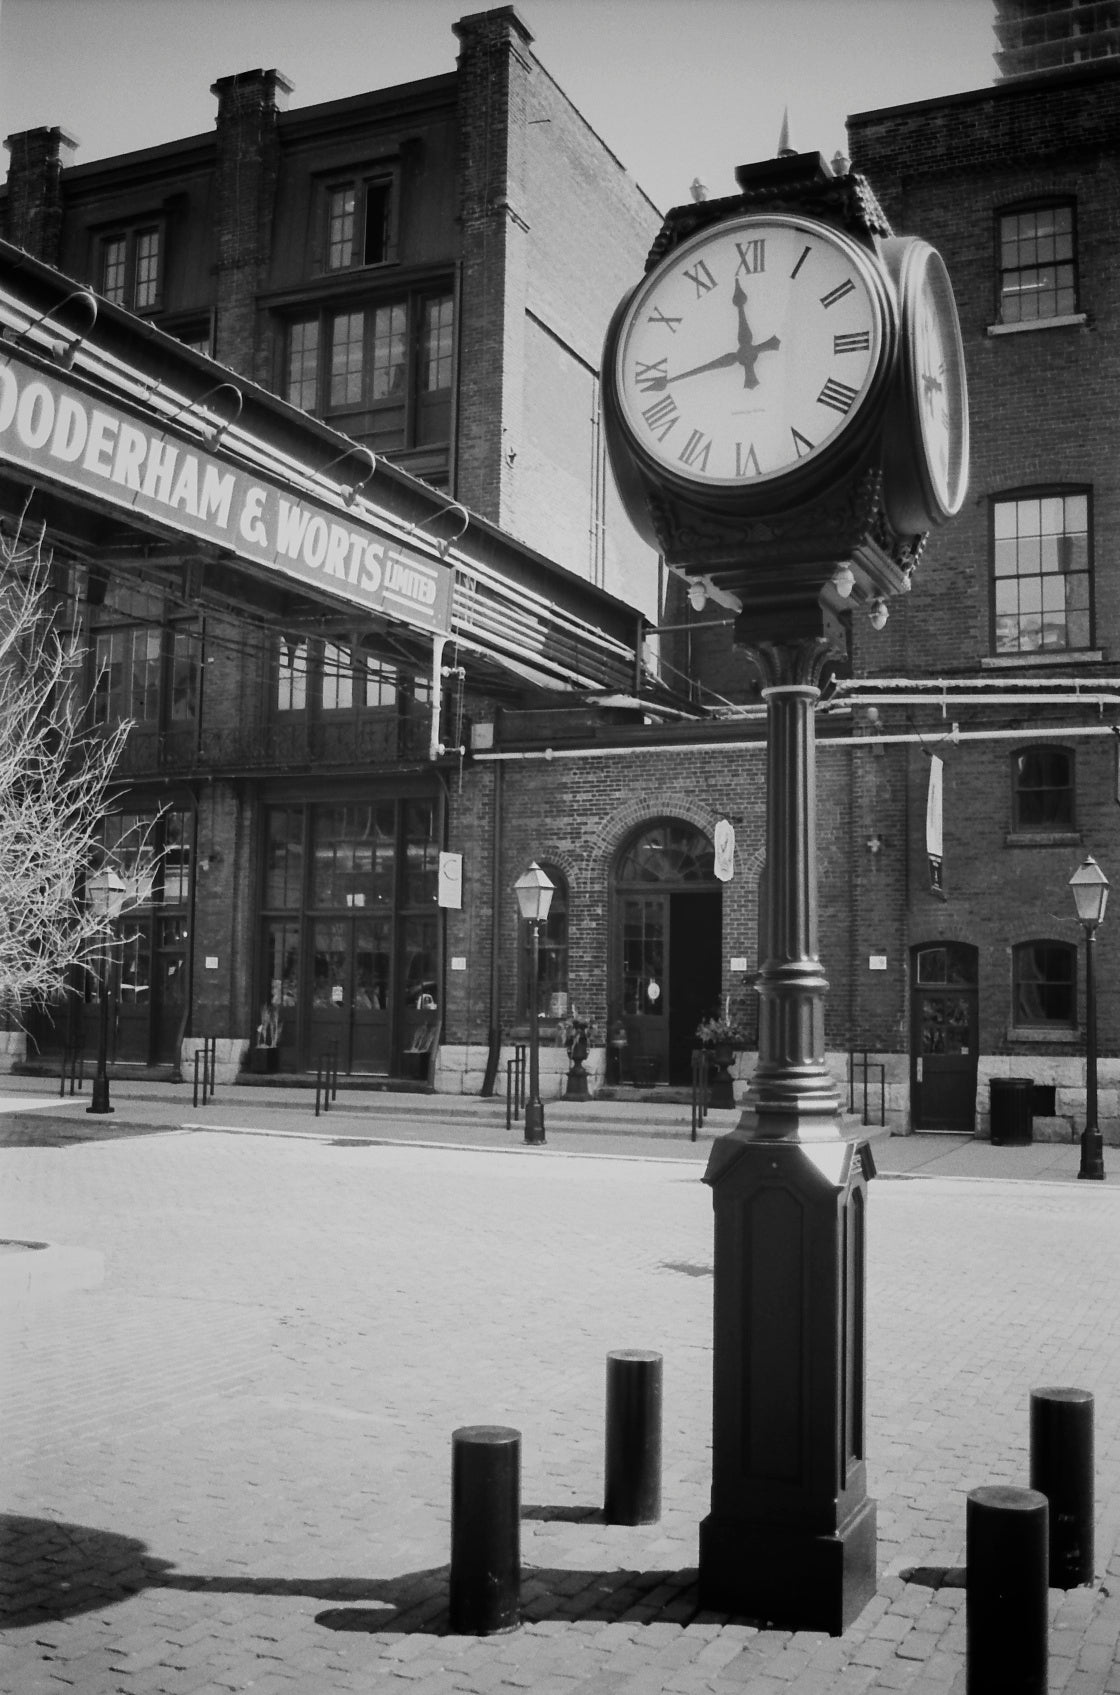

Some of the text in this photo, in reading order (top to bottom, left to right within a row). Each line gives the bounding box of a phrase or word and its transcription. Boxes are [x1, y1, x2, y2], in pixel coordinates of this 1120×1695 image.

[735, 239, 766, 276] XII
[683, 260, 718, 299] XI
[820, 278, 856, 308] II
[647, 306, 683, 333] X
[833, 331, 870, 355] III
[642, 394, 681, 442] VIII
[678, 429, 711, 472] VII
[735, 442, 762, 477] VI
[790, 427, 815, 458] V
[239, 486, 268, 548] &
[276, 492, 384, 592] WORTS
[384, 561, 436, 604] LIMITED
